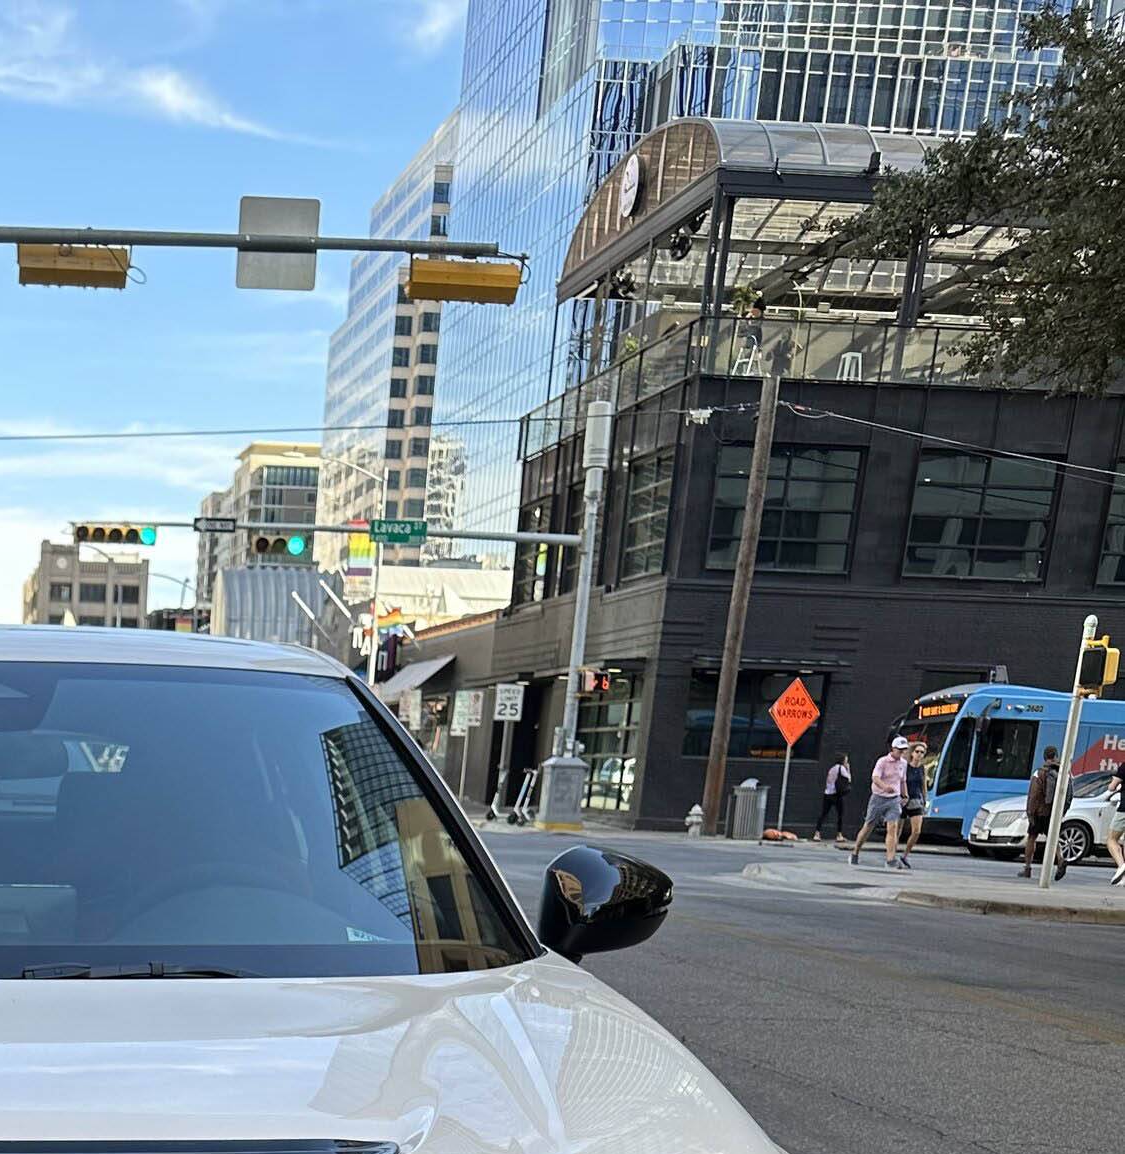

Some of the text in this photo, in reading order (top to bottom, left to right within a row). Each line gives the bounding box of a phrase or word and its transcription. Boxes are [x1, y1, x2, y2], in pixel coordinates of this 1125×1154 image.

[374, 520, 411, 535] Lavaca
[499, 688, 521, 696] SPEED
[785, 696, 807, 707] ROAD
[497, 703, 519, 717] 25
[777, 709, 813, 720] NARROWS
